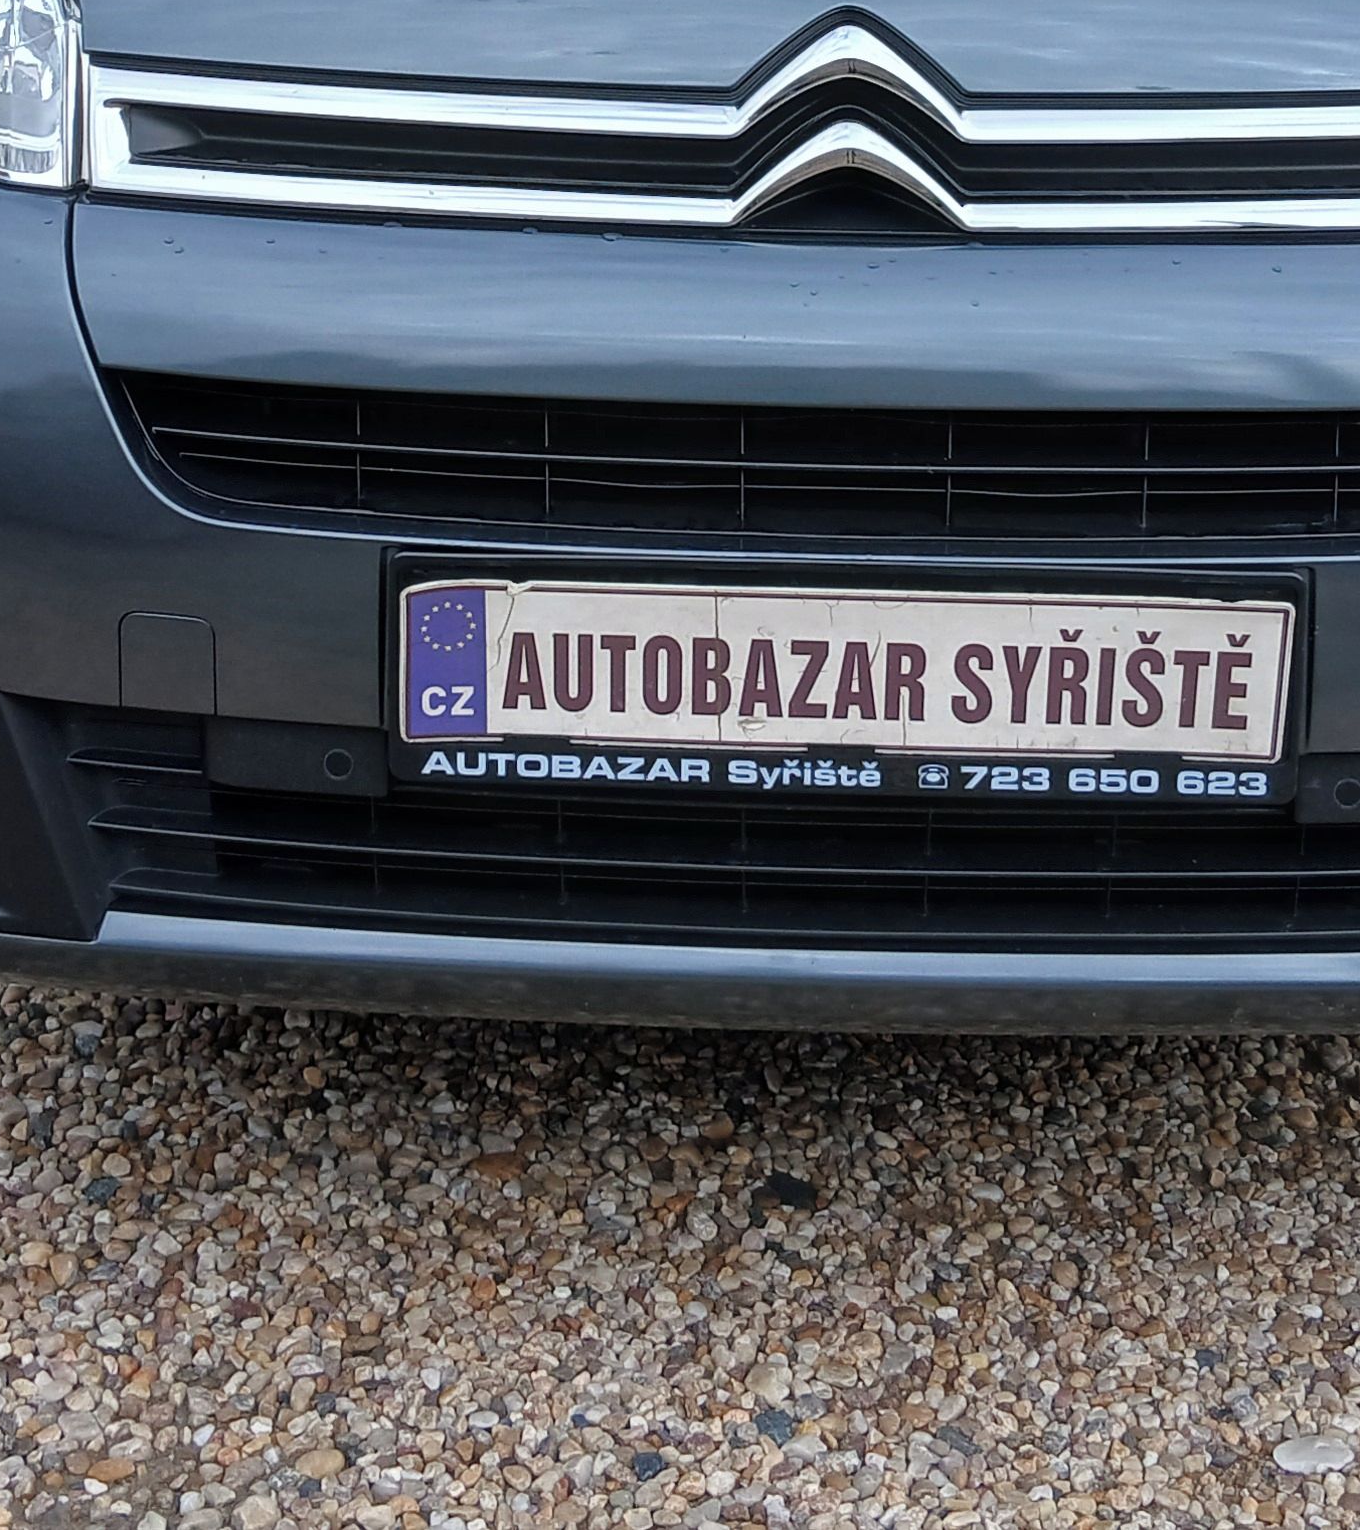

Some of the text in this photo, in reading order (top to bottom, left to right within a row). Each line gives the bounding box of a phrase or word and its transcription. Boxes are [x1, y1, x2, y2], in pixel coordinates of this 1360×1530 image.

[421, 685, 475, 716] CZ
[502, 628, 1253, 731] AUTOBAZAR SYŘIŠTĚ
[421, 750, 1269, 797] AUTOBAZAR Syřiště 723 650 623
